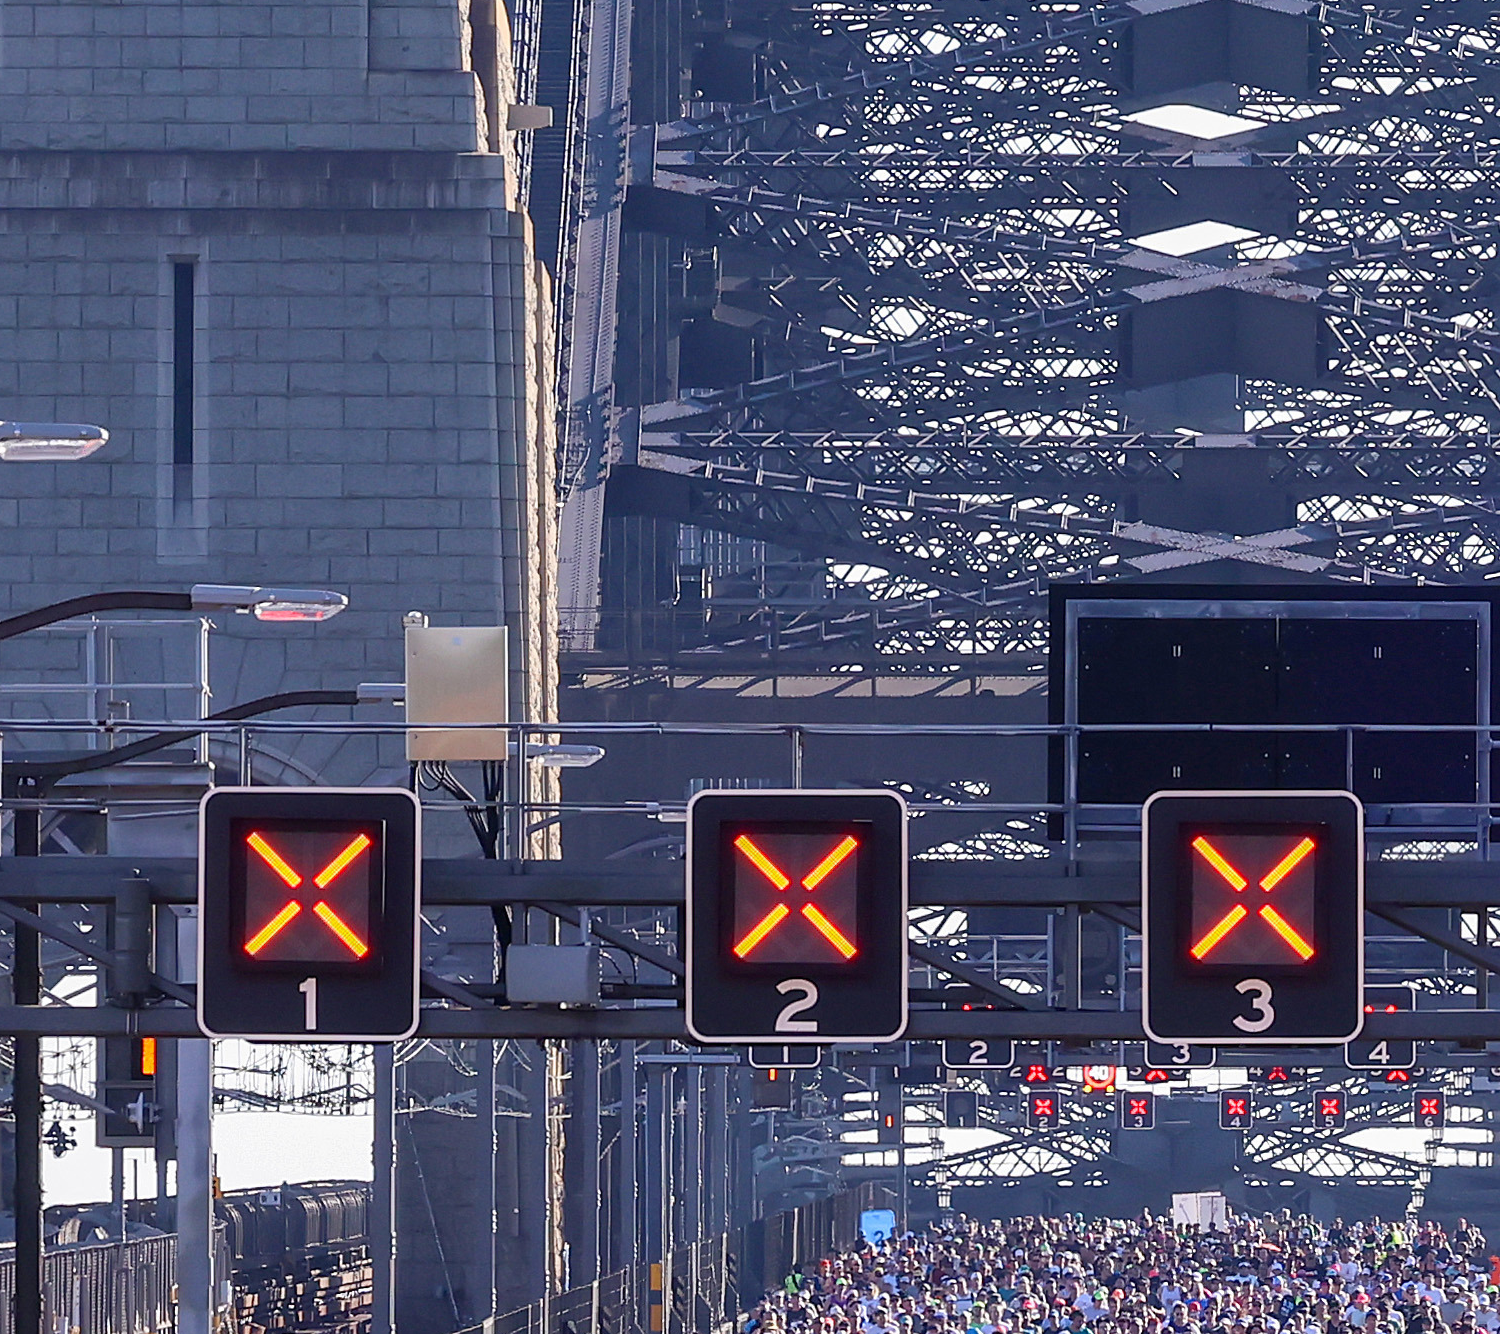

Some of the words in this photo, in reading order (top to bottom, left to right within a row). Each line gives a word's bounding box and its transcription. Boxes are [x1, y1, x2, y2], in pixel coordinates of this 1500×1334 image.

[299, 977, 317, 1030] 1
[774, 978, 818, 1032] 2
[1232, 978, 1275, 1033] 3
[968, 1040, 989, 1064] 2
[1171, 1043, 1191, 1064] 3
[1368, 1040, 1391, 1065] 4
[959, 1116, 964, 1127] 1
[1038, 1116, 1049, 1128] 2
[1134, 1116, 1144, 1128] 3
[1230, 1116, 1242, 1128] 4
[1325, 1116, 1335, 1128] 5
[1424, 1116, 1434, 1128] 6
